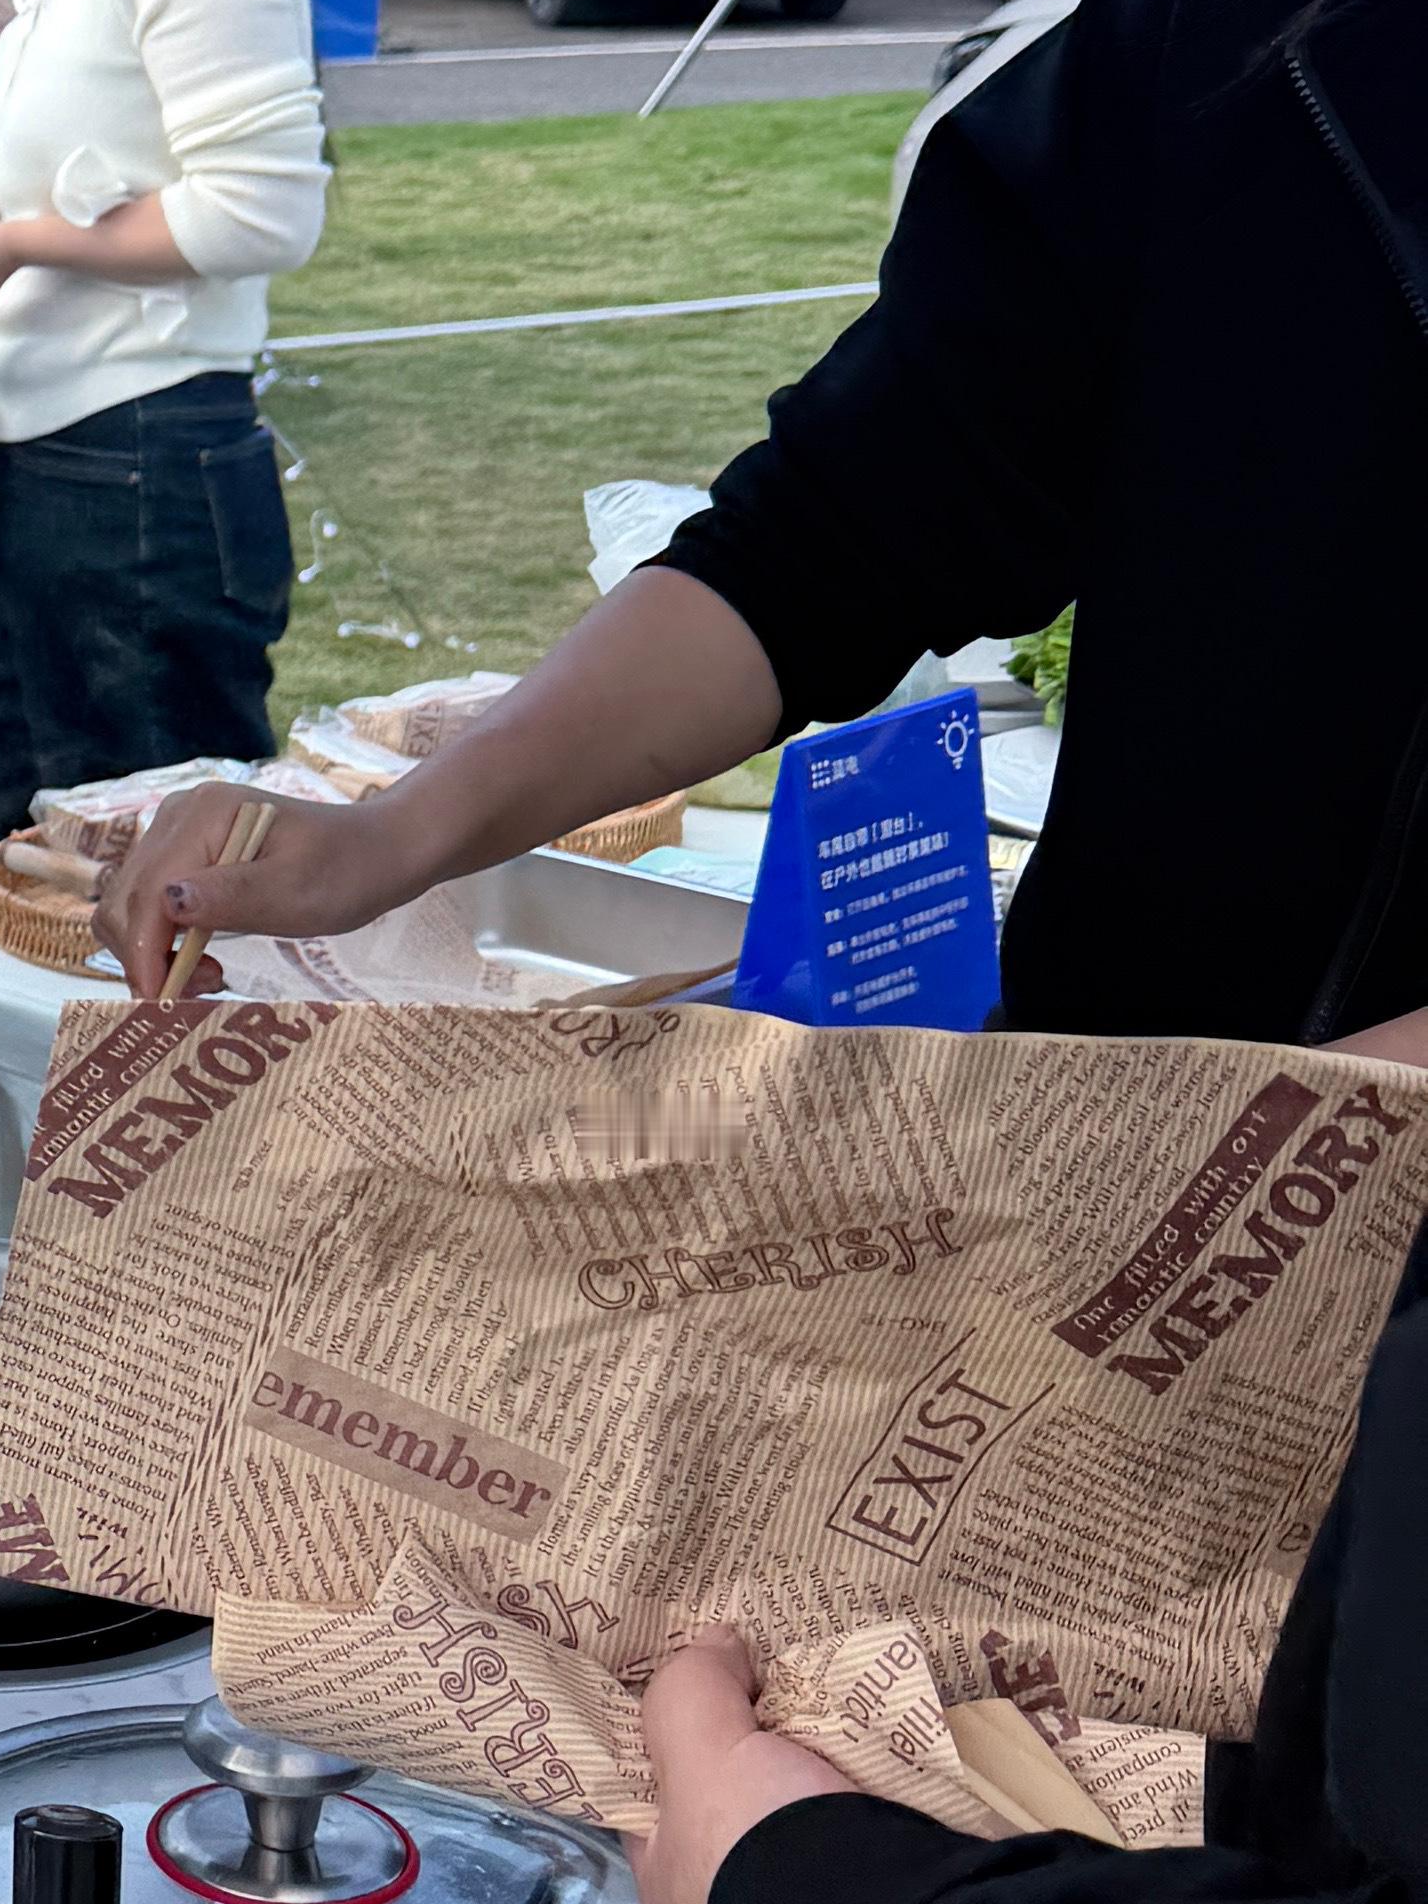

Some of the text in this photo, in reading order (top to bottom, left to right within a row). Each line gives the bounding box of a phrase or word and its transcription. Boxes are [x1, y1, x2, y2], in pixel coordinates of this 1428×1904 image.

[105, 1012, 155, 1063] with
[578, 1205, 965, 1312] CHERISH
[1108, 1081, 1411, 1399] MEMORY
[1120, 1220, 1182, 1291] filled
[1178, 1159, 1229, 1217] with
[372, 1306, 424, 1378] Remember
[852, 1365, 1015, 1550] EXIST
[308, 1614, 351, 1642] hand
[1142, 1762, 1199, 1807] Wind
